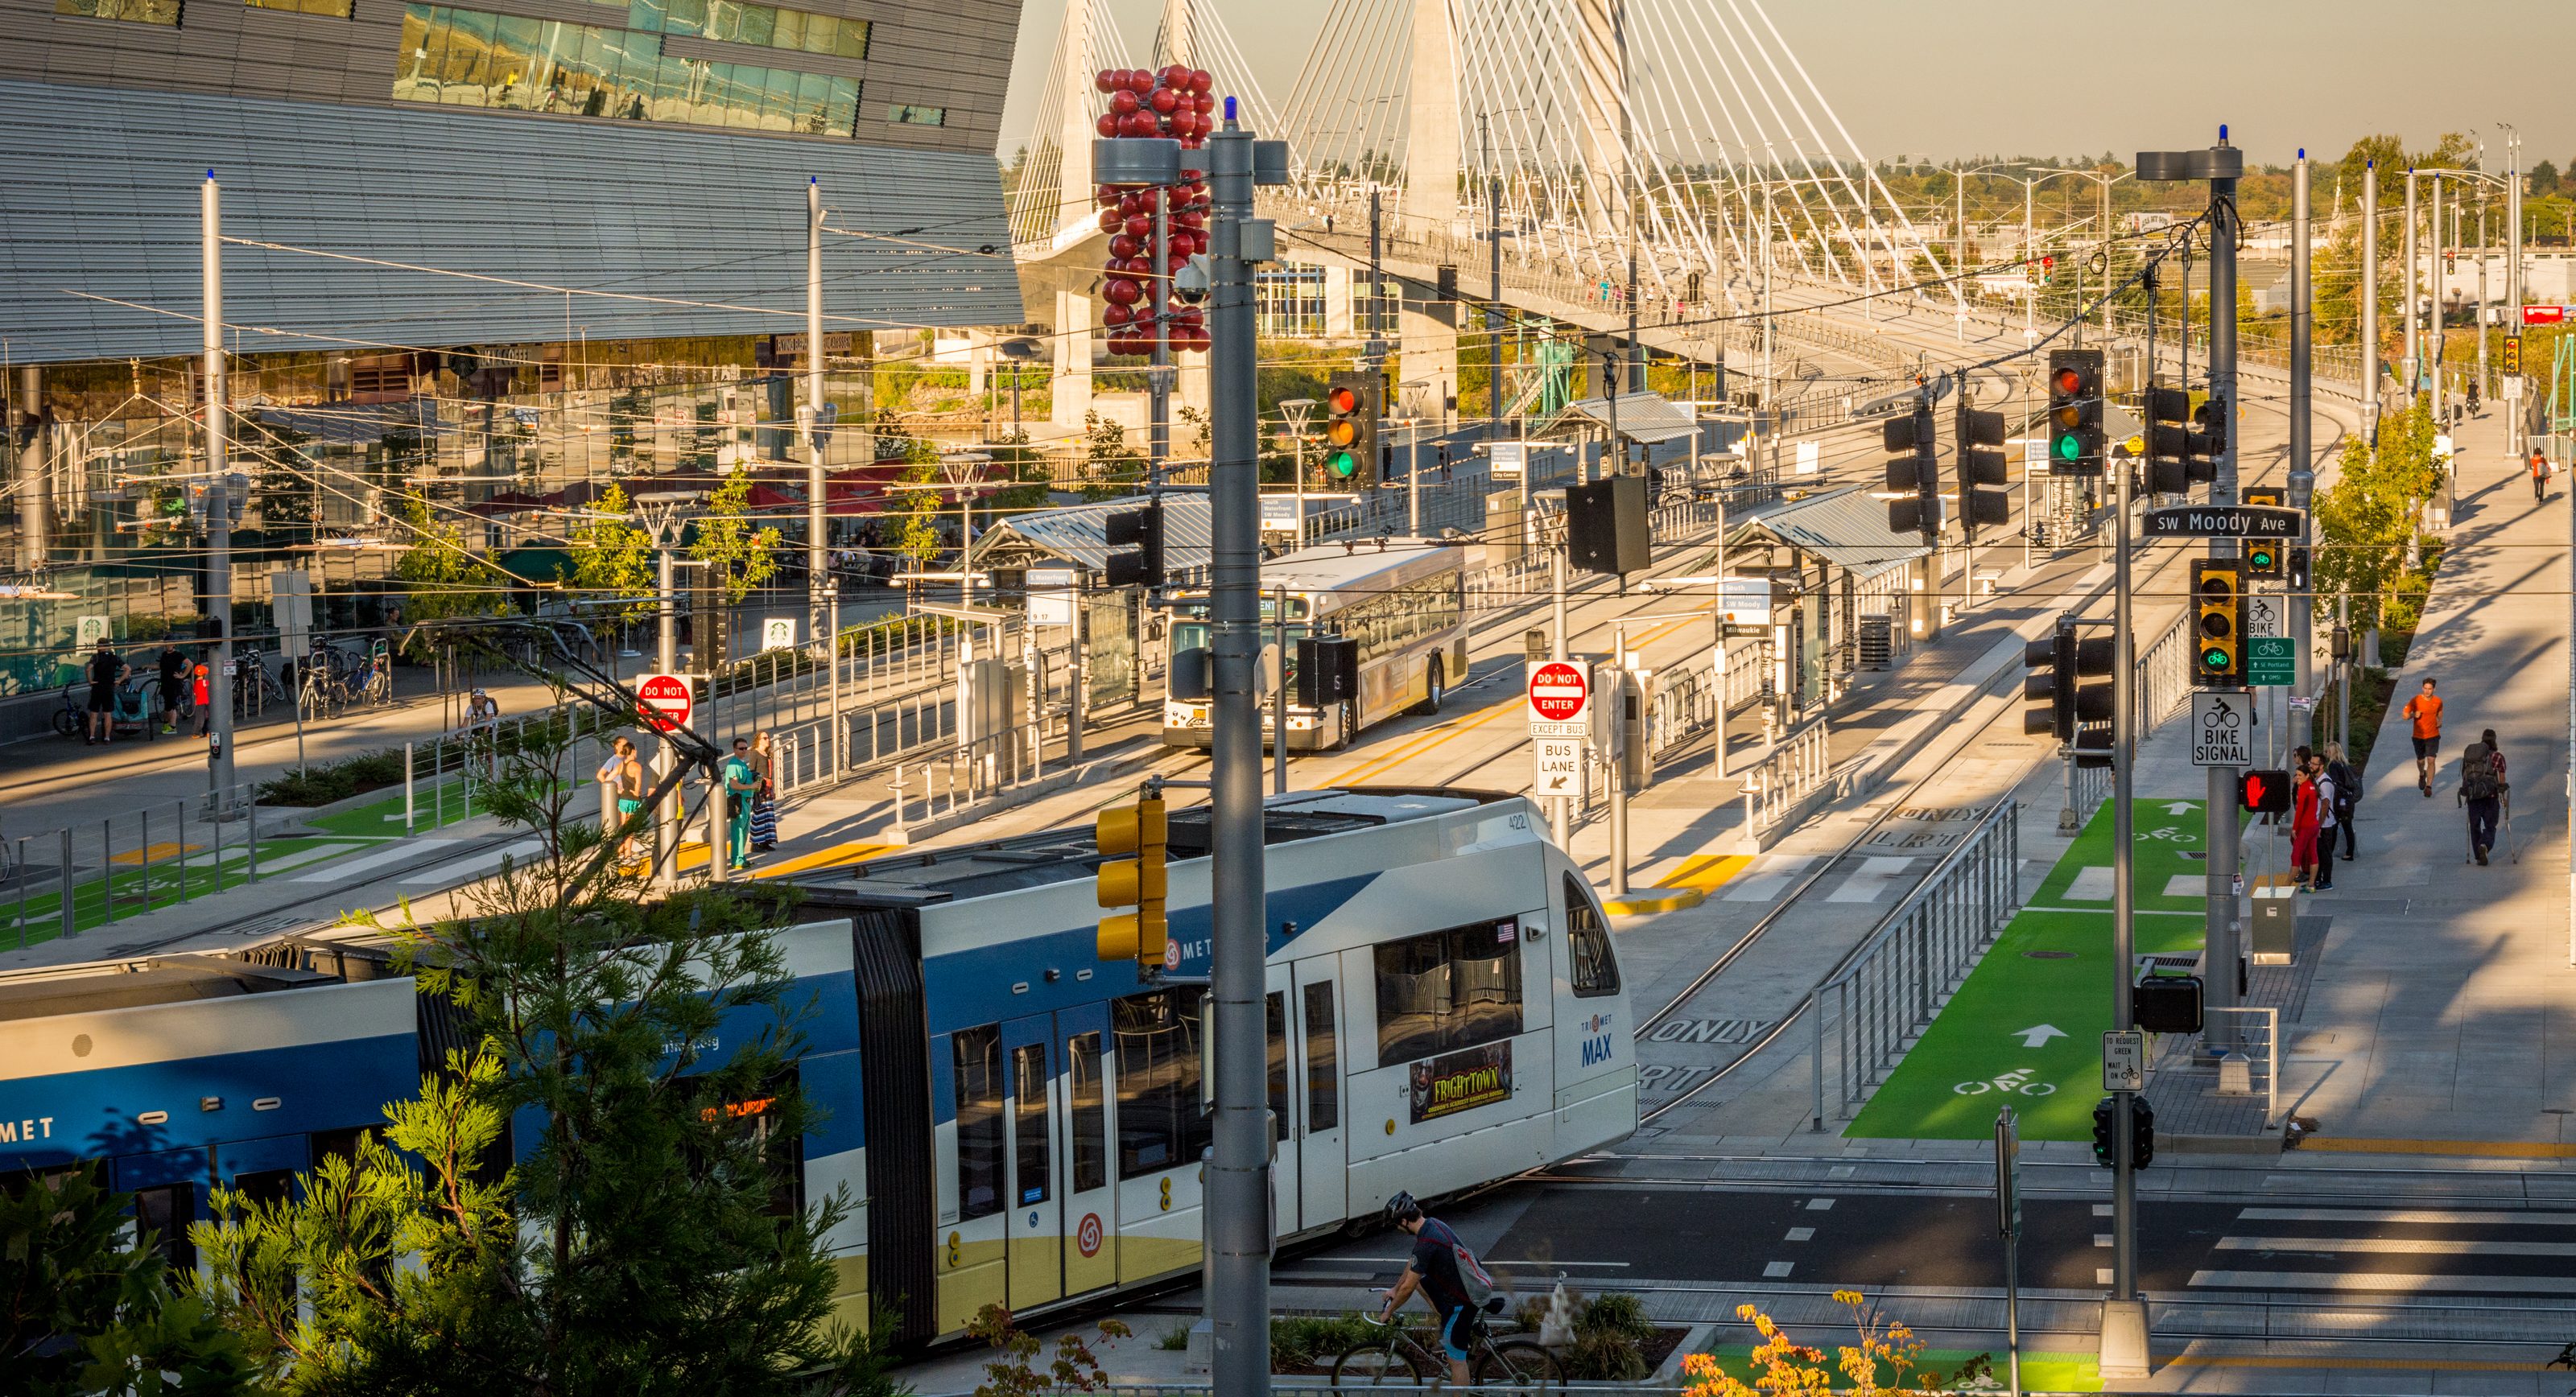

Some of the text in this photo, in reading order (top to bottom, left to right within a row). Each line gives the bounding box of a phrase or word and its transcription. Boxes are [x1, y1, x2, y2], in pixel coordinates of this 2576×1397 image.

[2157, 513, 2285, 535] SW Moody Ave
[1738, 600, 1761, 609] Moody
[2249, 622, 2273, 633] BIKE
[1538, 674, 1578, 683] DO NOT
[645, 686, 683, 696] DO NOT
[1542, 700, 1574, 710] ENTER
[1533, 725, 1583, 734] EXCEPT BUS
[2205, 730, 2239, 744] BIKE
[1546, 745, 1571, 756] BUS
[2196, 746, 2248, 760] SIGNAL
[1542, 761, 1575, 772] LANE
[1509, 814, 1526, 830] 422
[1183, 938, 1212, 960] MET
[1600, 1014, 1612, 1026] MET
[1649, 1019, 1777, 1044] ONLY
[1582, 1032, 1612, 1068] MAX
[1637, 1064, 1719, 1090] RT
[1434, 1066, 1499, 1103] FRIGHTTOWN
[0, 1117, 53, 1143] MET
